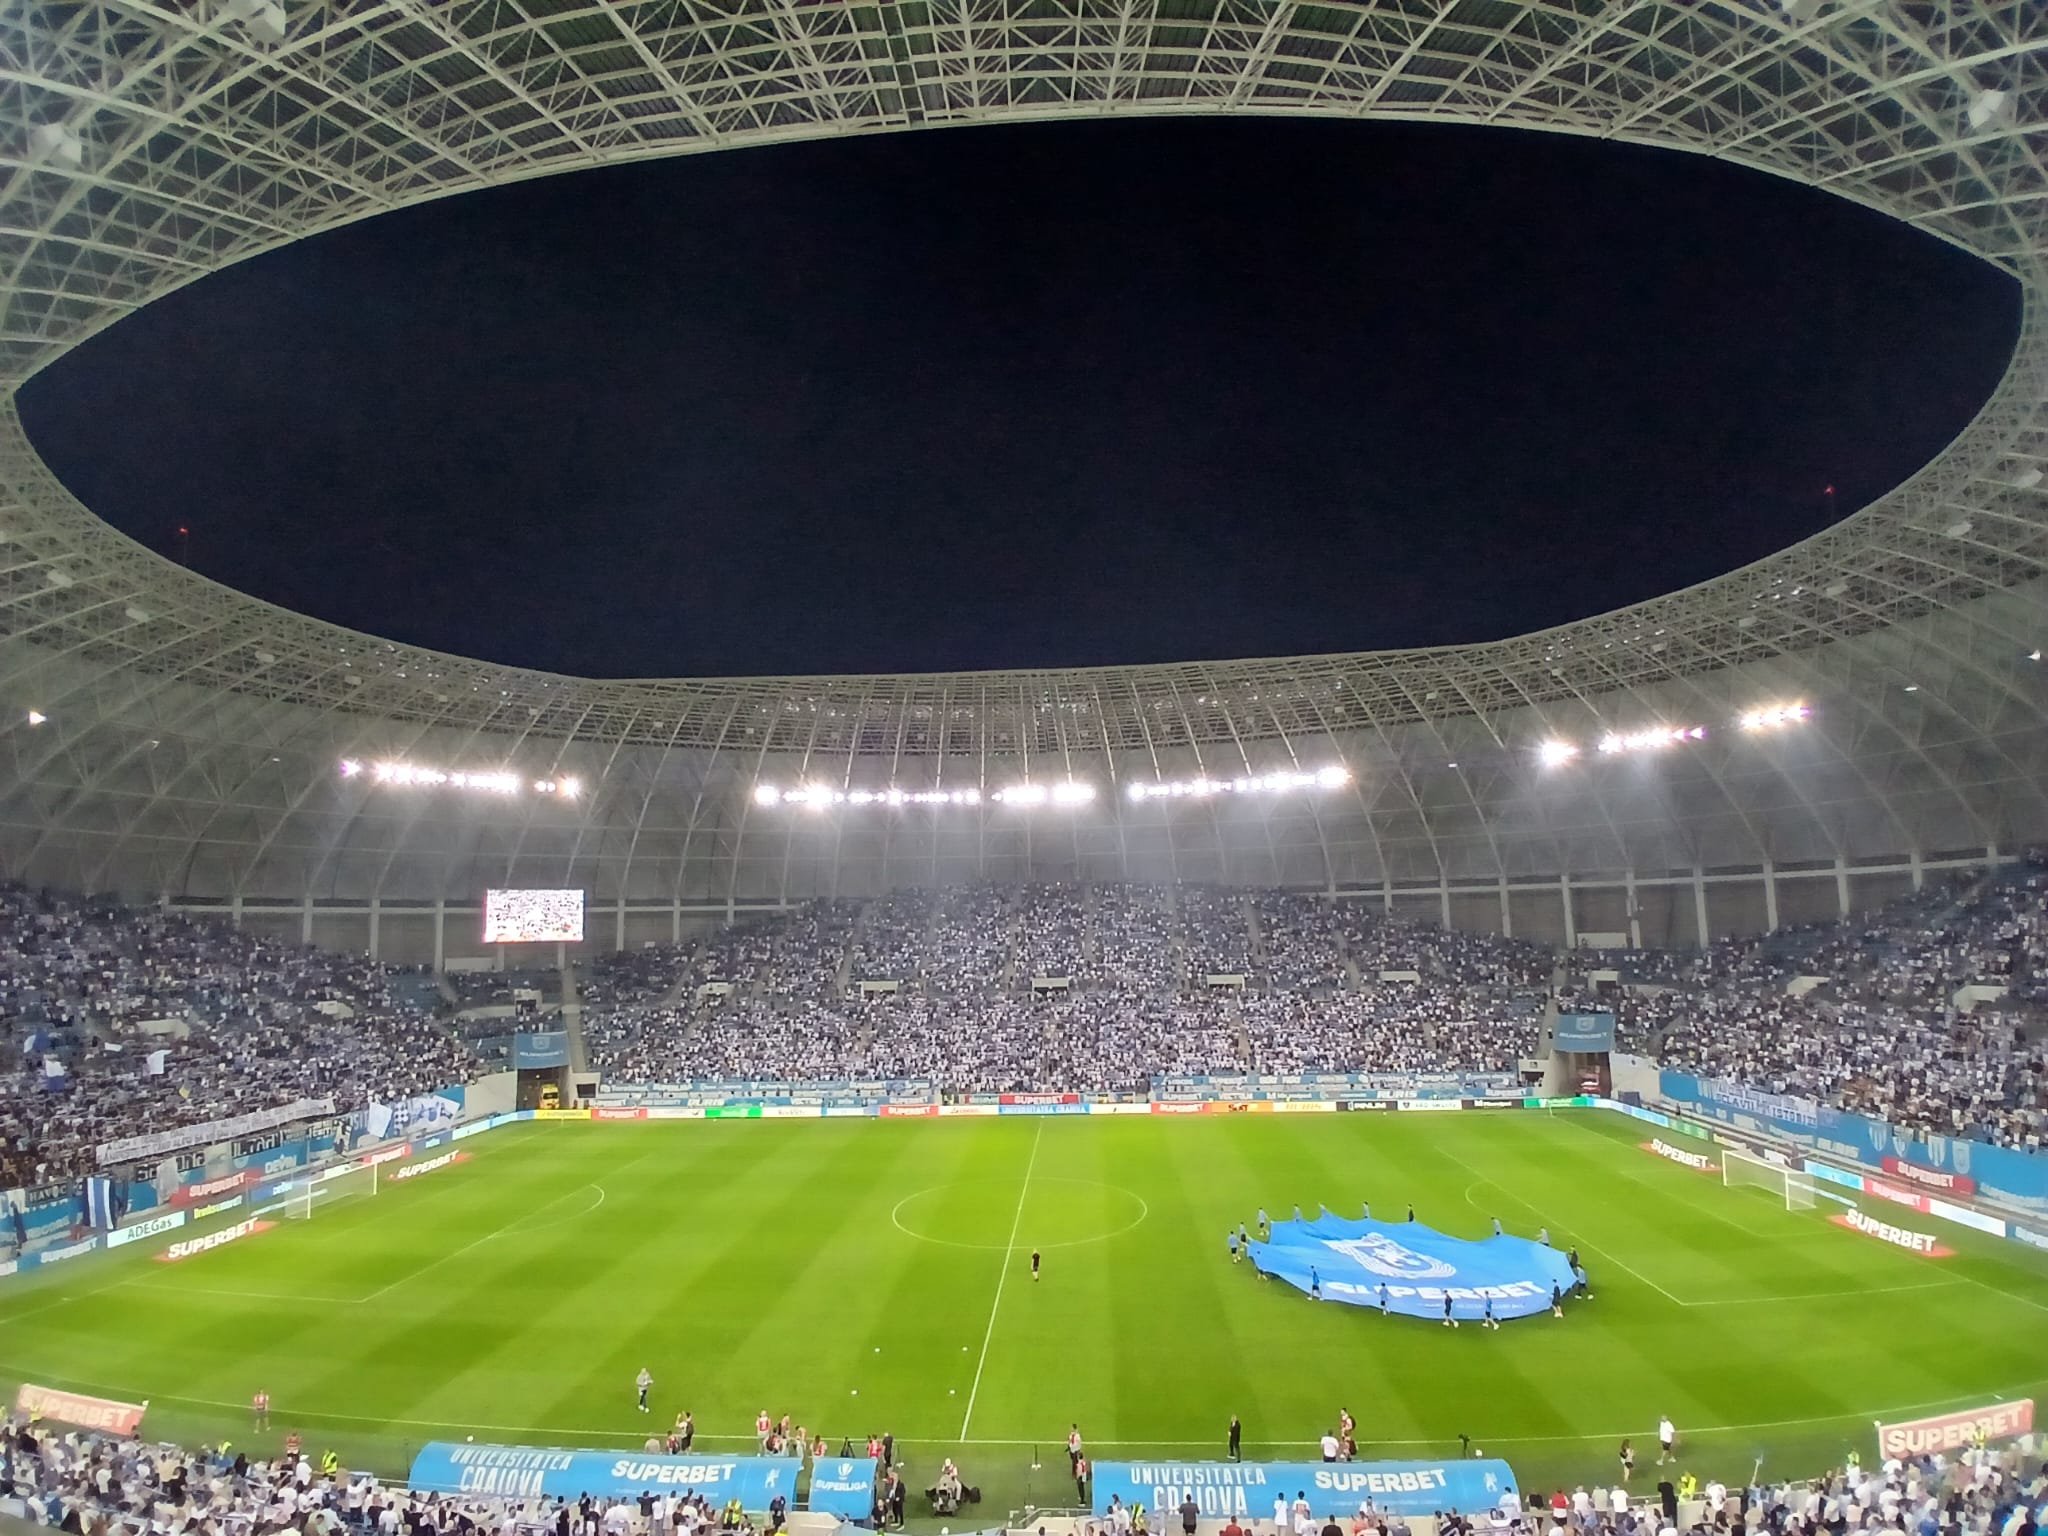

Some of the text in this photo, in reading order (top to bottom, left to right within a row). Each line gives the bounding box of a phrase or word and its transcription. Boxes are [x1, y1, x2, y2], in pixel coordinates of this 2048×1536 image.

[397, 1150, 460, 1179] SUPERBET
[1651, 1138, 1709, 1169] SUPERBET
[127, 1219, 172, 1240] ADEGas
[167, 1217, 259, 1259] SUPERBET
[1845, 1209, 1936, 1252] SUPERBET
[1886, 1407, 2022, 1454] SUPERBET
[450, 1447, 573, 1471] UNIVERSITATEA
[611, 1459, 736, 1485] SUPERBET
[459, 1466, 545, 1498] CRAIOVA
[815, 1479, 868, 1492] SUPERLIGA
[1130, 1466, 1267, 1486] UNIVERSITATEA
[1314, 1468, 1447, 1493] SUPERBET
